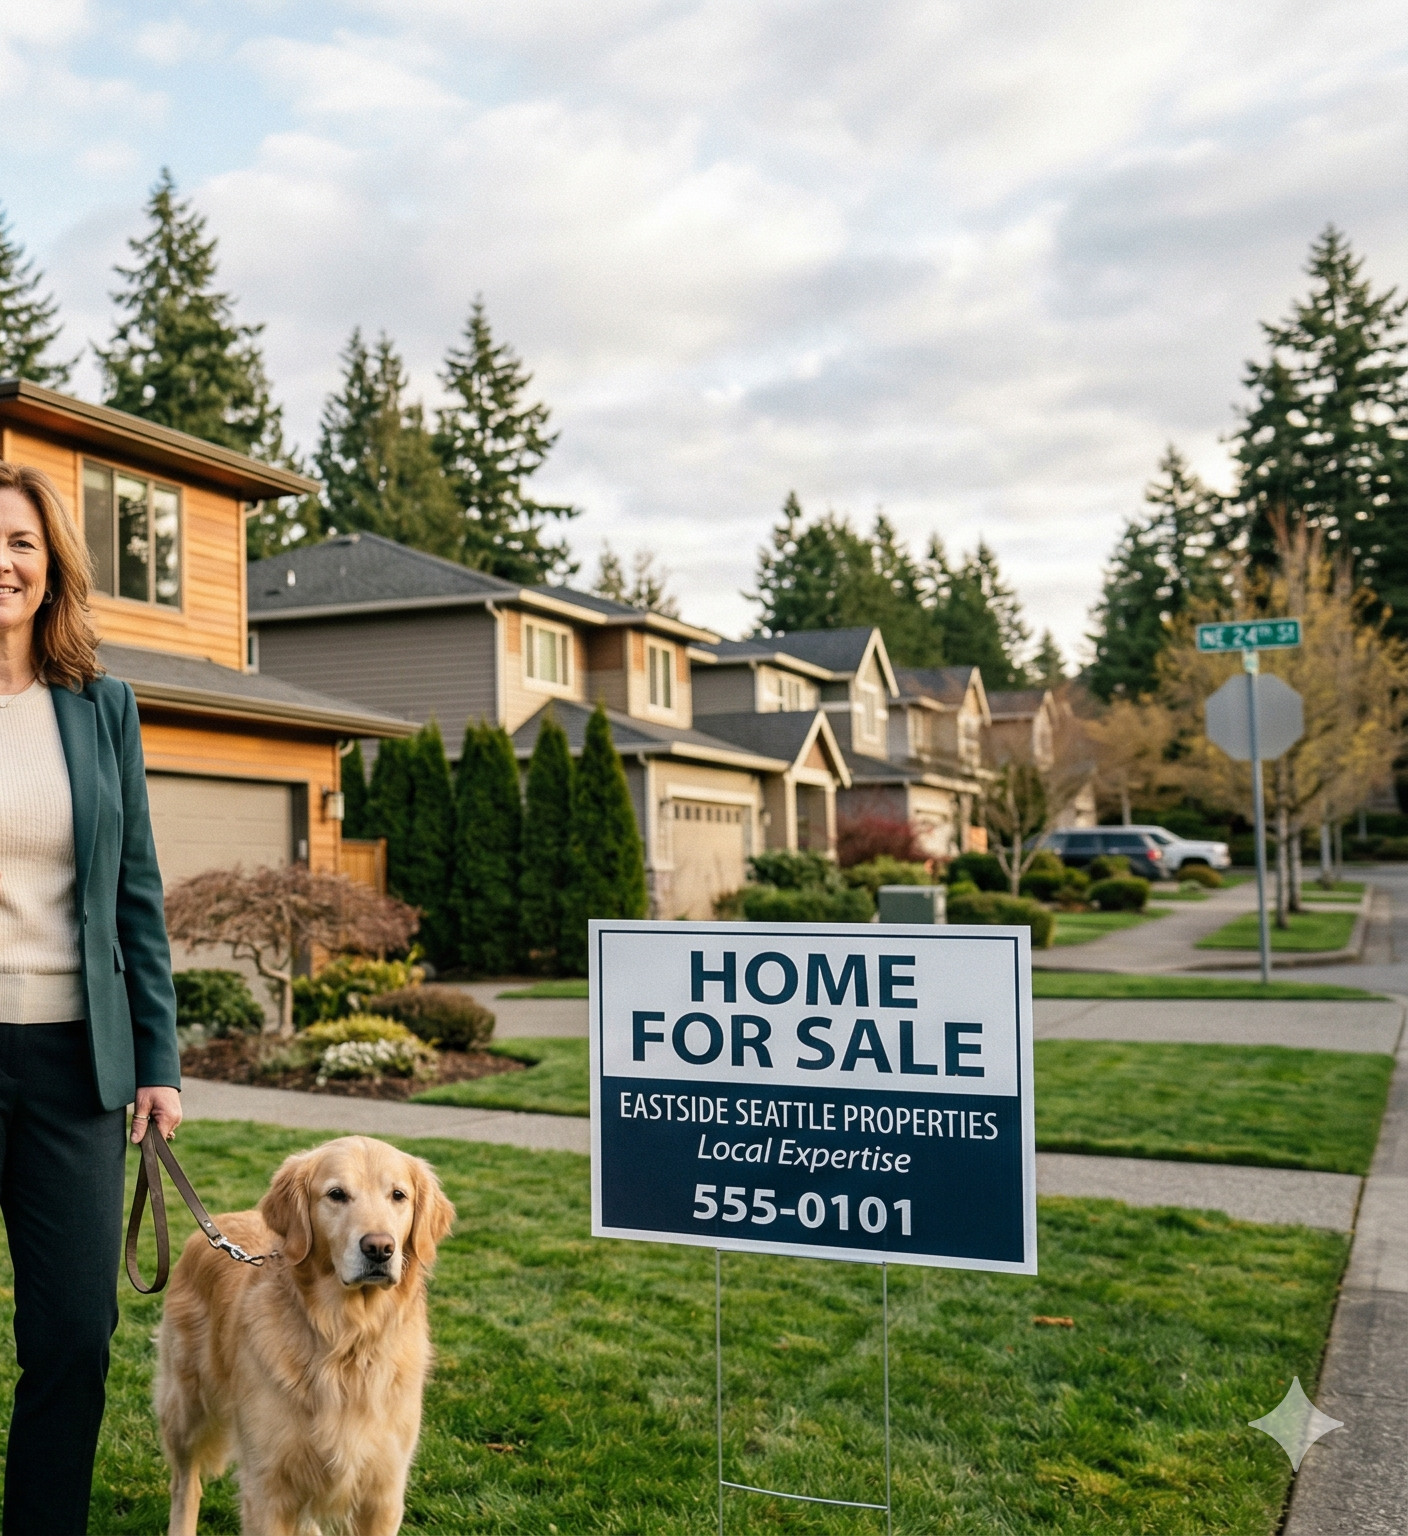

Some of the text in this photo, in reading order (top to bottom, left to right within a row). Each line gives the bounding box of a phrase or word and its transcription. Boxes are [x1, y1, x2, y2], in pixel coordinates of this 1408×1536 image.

[1202, 628, 1225, 648] NE
[691, 950, 918, 1009] HOME
[632, 1010, 985, 1078] FOR SALE
[620, 1092, 999, 1140] EASTSIDE SEATTLE PROPERTIES
[697, 1134, 912, 1173] Local Expertise
[692, 1184, 912, 1236] 555-0101
